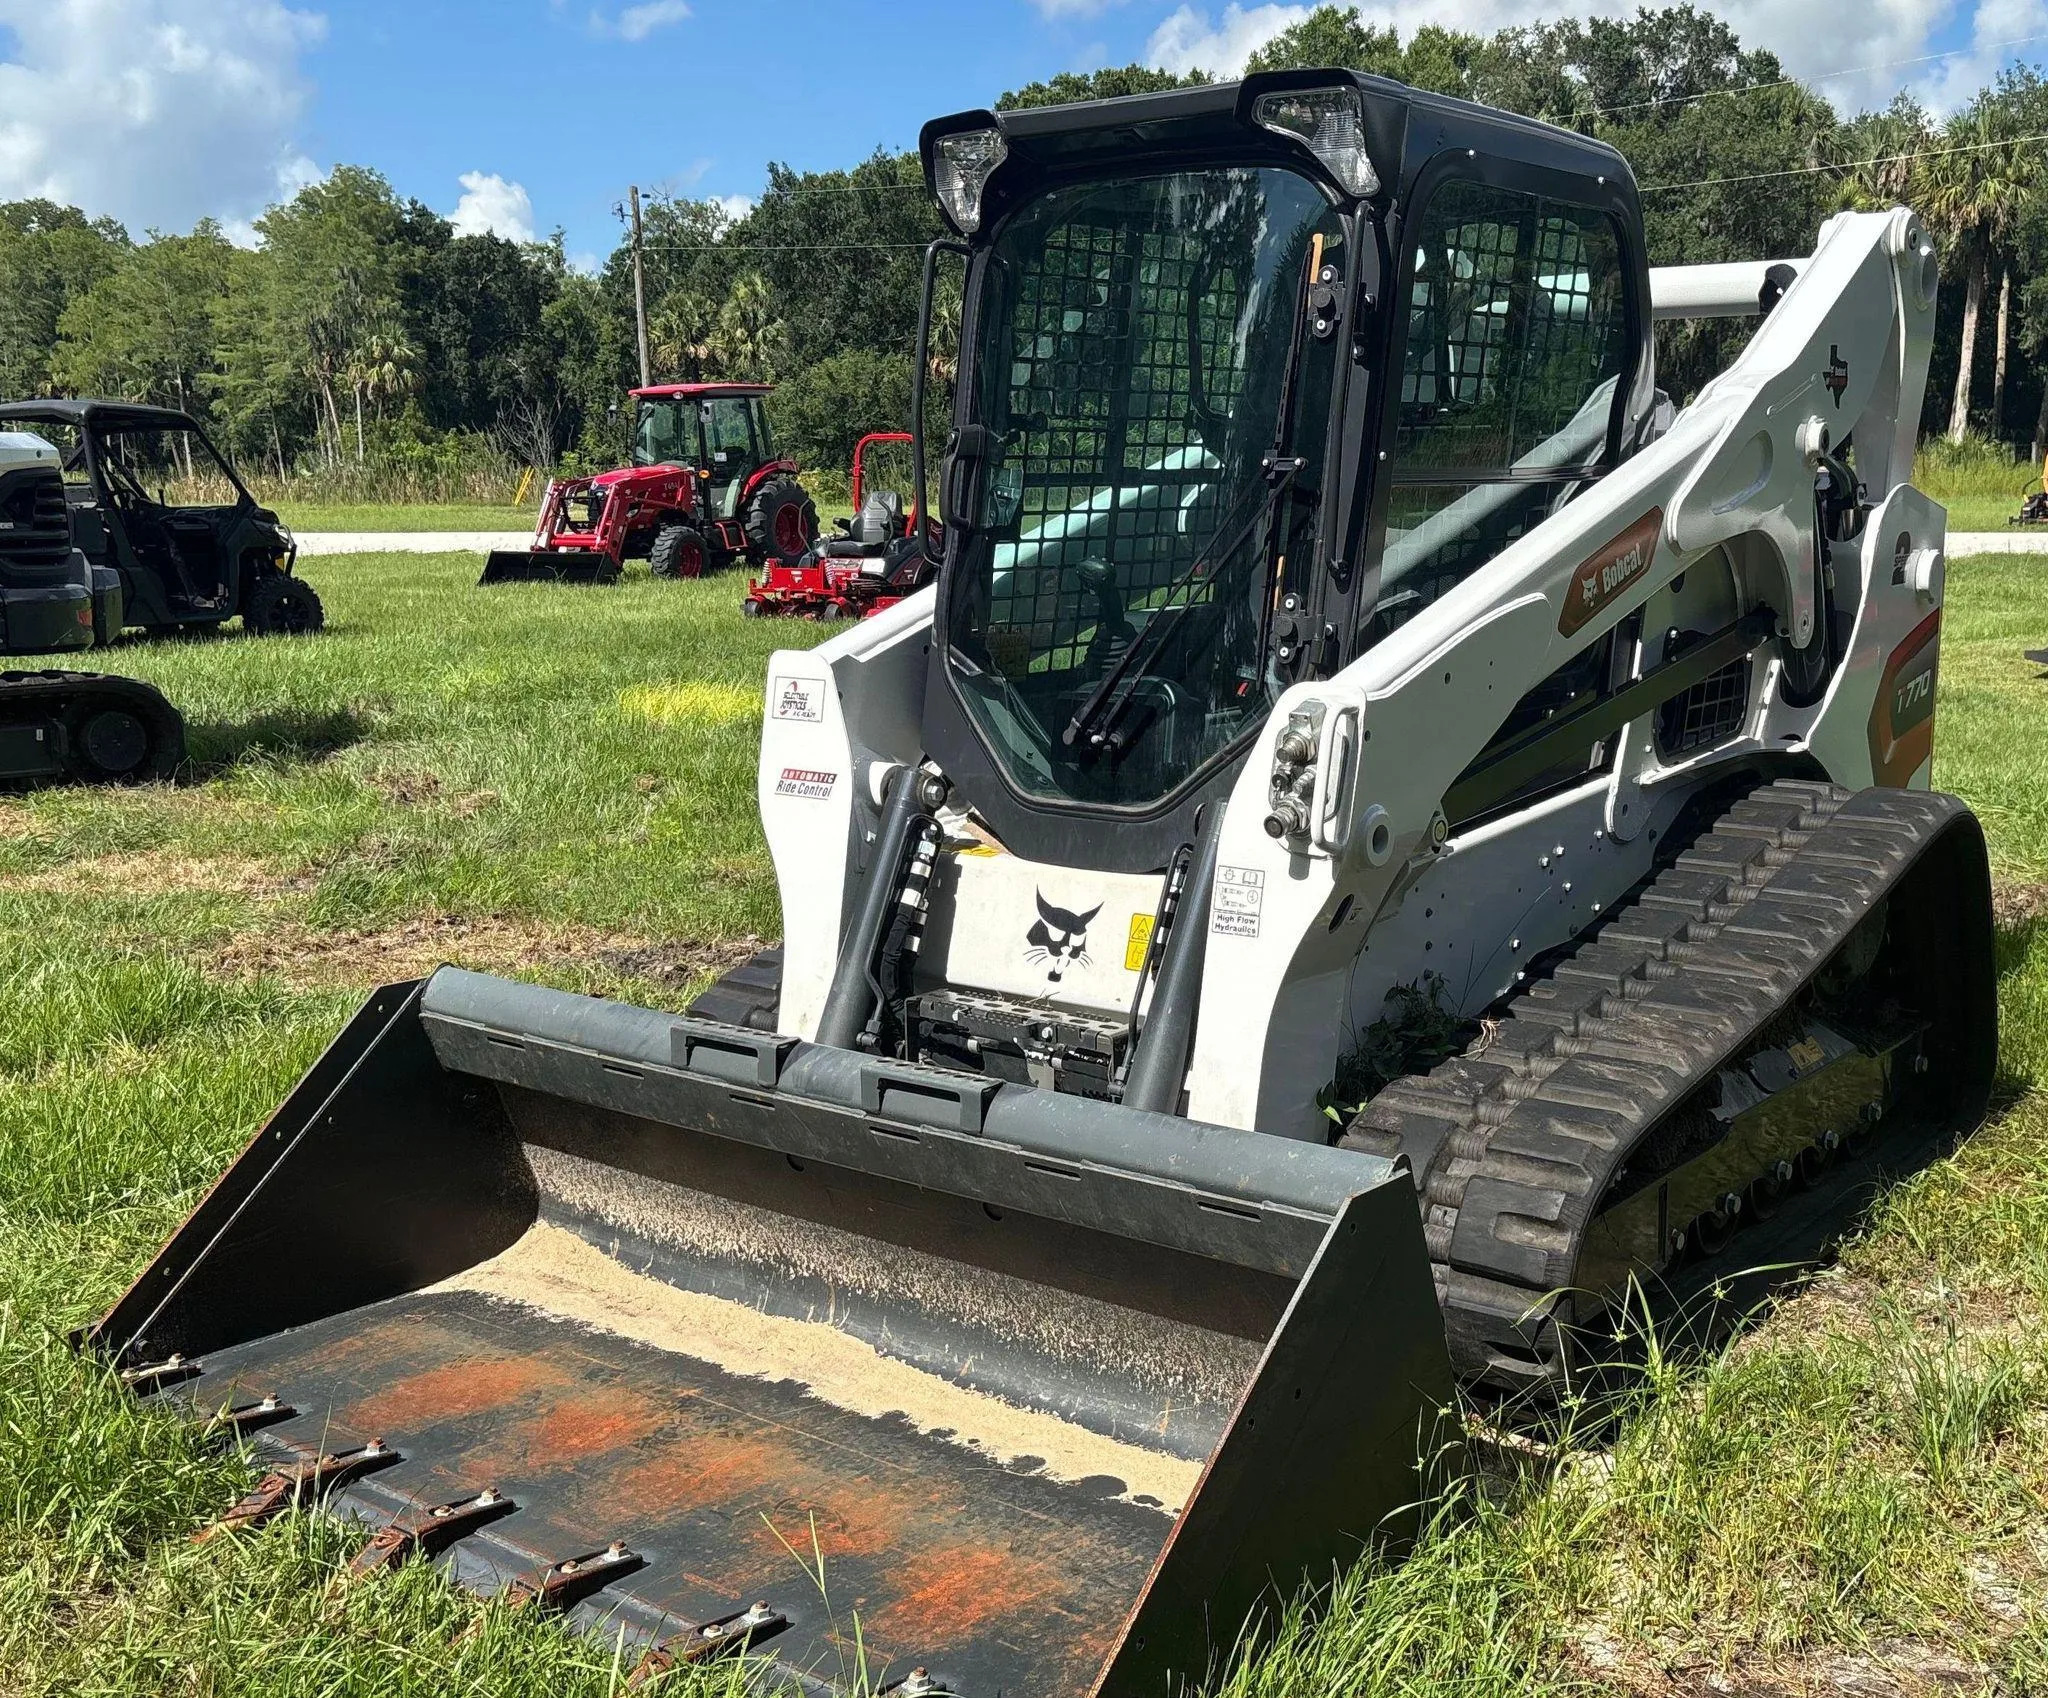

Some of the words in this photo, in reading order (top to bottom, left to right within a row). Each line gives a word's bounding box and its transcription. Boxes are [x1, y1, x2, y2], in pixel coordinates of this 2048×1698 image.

[1602, 542, 1642, 595] Bobcat
[1897, 668, 1932, 714] T770
[782, 769, 836, 784] AUTOMATIC
[776, 780, 796, 794] Ride
[797, 782, 832, 797] Control
[1217, 914, 1234, 924] High
[1237, 916, 1255, 925] Flow
[1215, 923, 1256, 934] Hydraulics
